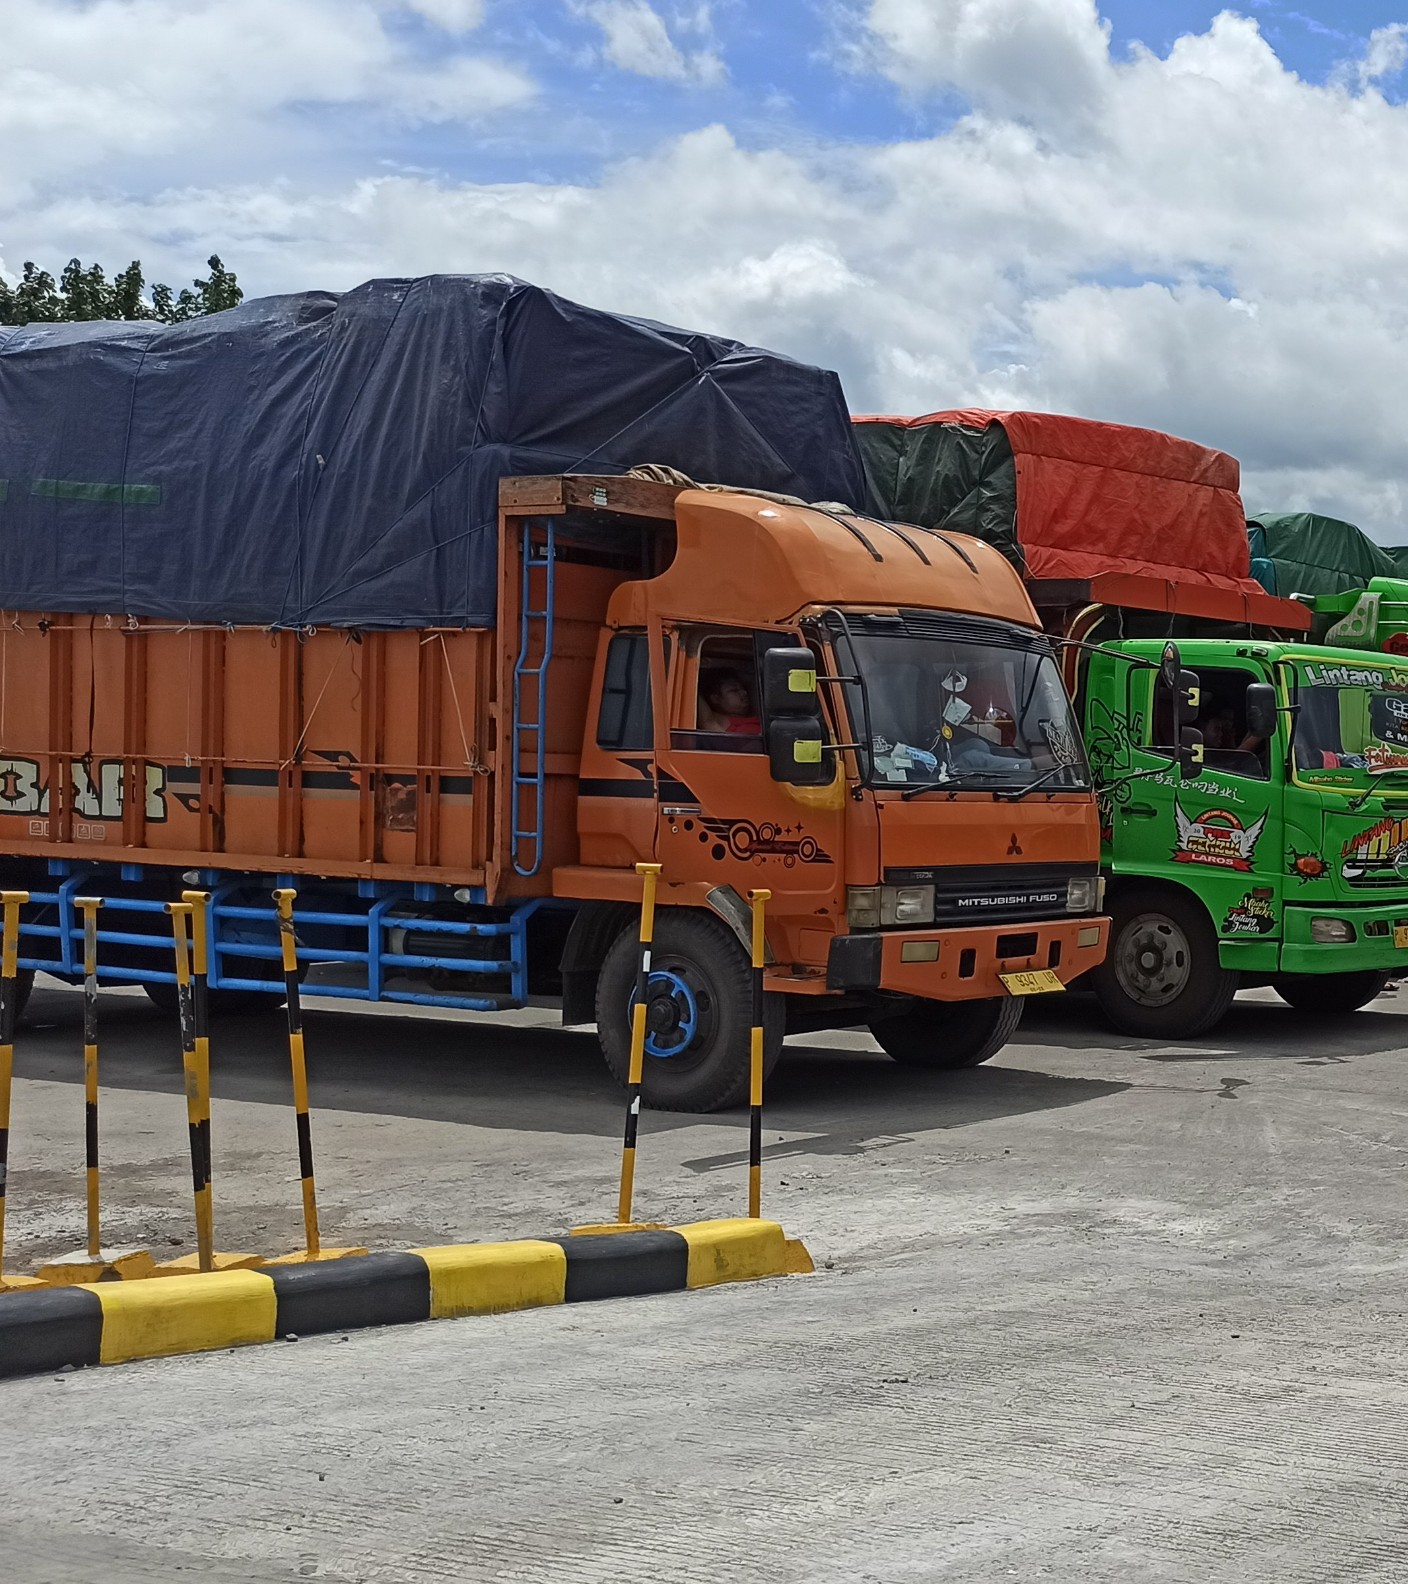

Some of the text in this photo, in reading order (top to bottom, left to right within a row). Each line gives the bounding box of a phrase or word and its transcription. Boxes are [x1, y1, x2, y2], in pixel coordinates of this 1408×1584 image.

[1304, 664, 1384, 690] Lintang
[1341, 815, 1394, 858] LINTANG
[1191, 853, 1235, 866] LAROS
[958, 893, 1058, 907] MITSUBISHI FUSO
[1002, 976, 1011, 988] P
